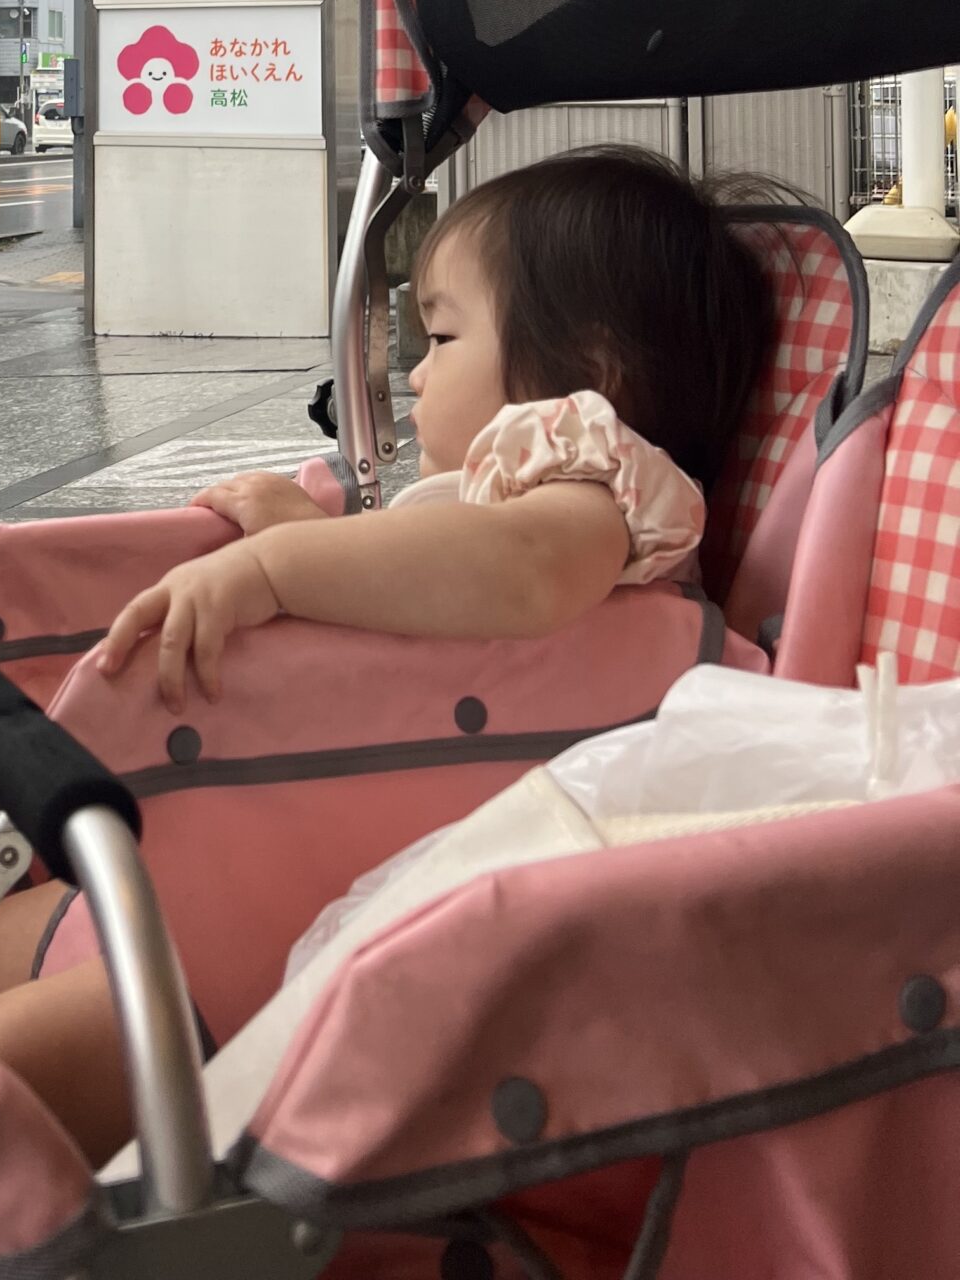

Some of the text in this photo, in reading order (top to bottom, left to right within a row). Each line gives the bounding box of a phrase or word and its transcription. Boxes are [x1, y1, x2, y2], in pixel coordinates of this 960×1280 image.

[209, 38, 291, 57] あなかれ
[209, 63, 303, 82] ほいくえん
[210, 88, 248, 108] 高松
